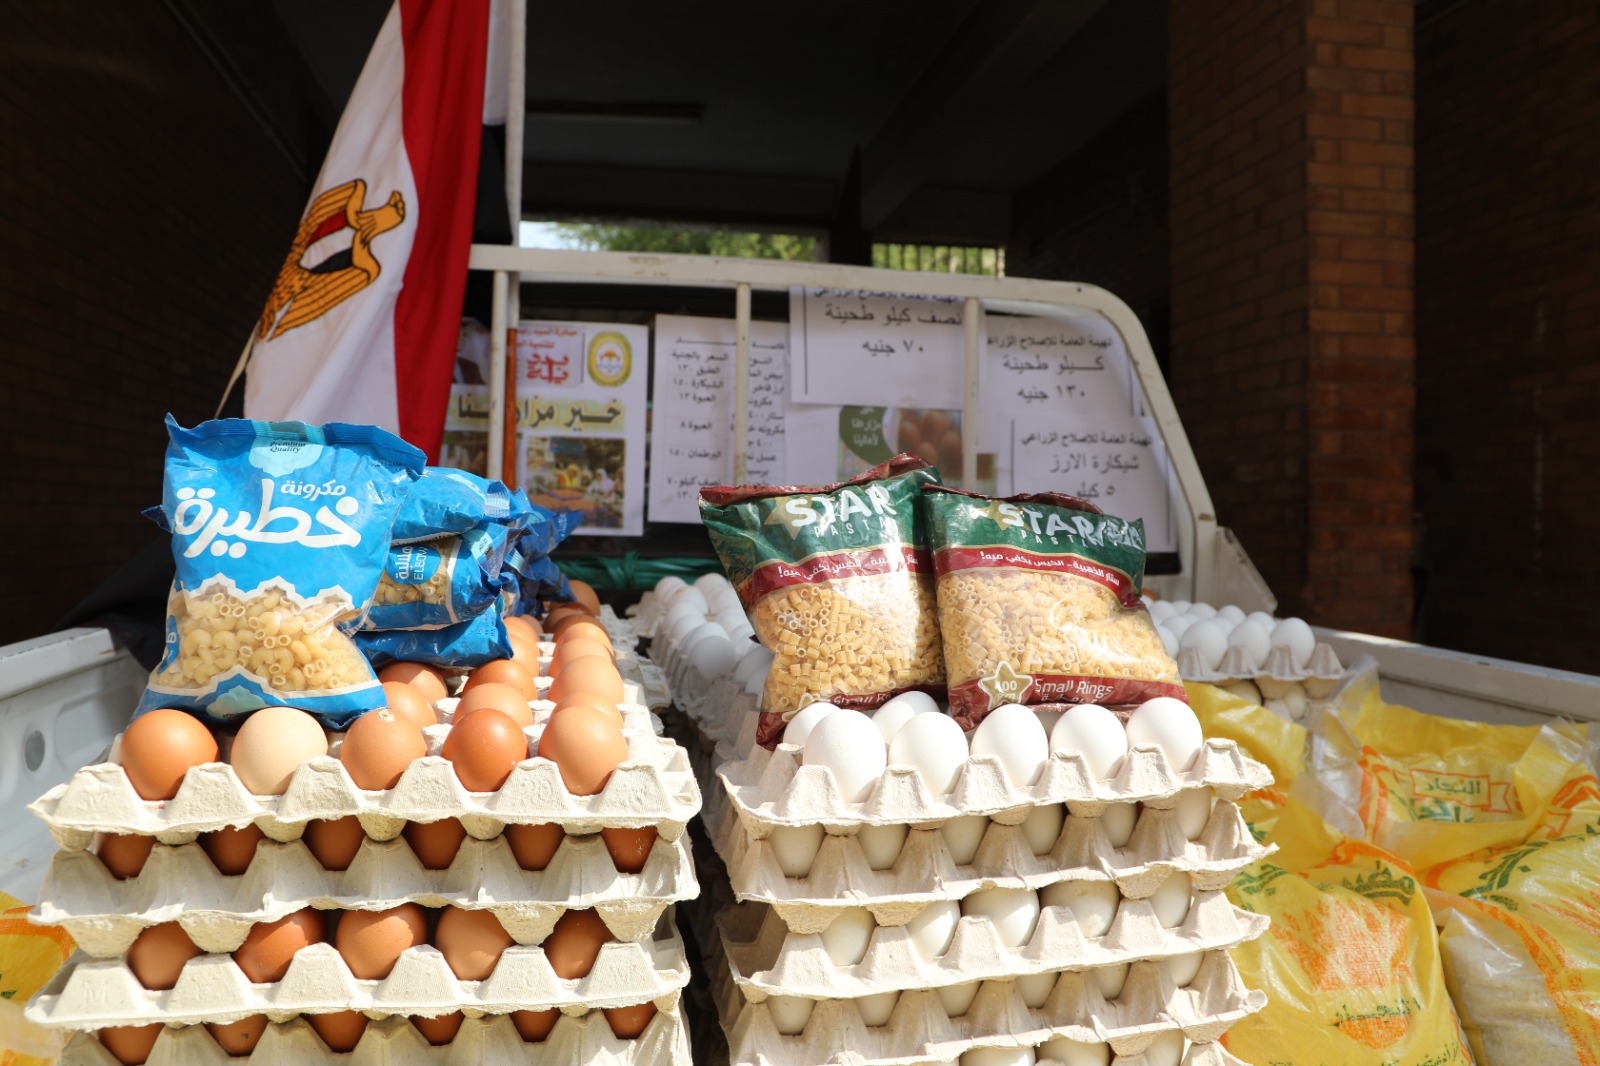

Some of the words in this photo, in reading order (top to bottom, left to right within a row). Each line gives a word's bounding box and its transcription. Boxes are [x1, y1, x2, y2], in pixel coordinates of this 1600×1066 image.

[824, 302, 876, 325] طحينة
[883, 304, 912, 327] كيلو
[917, 309, 962, 326] نصف
[1003, 353, 1049, 375] طحينة
[1056, 354, 1105, 376] كيلو
[563, 398, 622, 432] خير
[269, 446, 302, 454] Quality
[281, 479, 347, 501] مكرونة
[785, 484, 897, 527] STAR
[173, 478, 362, 559] خطيرة
[998, 503, 1100, 547] STAR
[1035, 678, 1074, 693] Small
[1075, 680, 1115, 699] Rings
